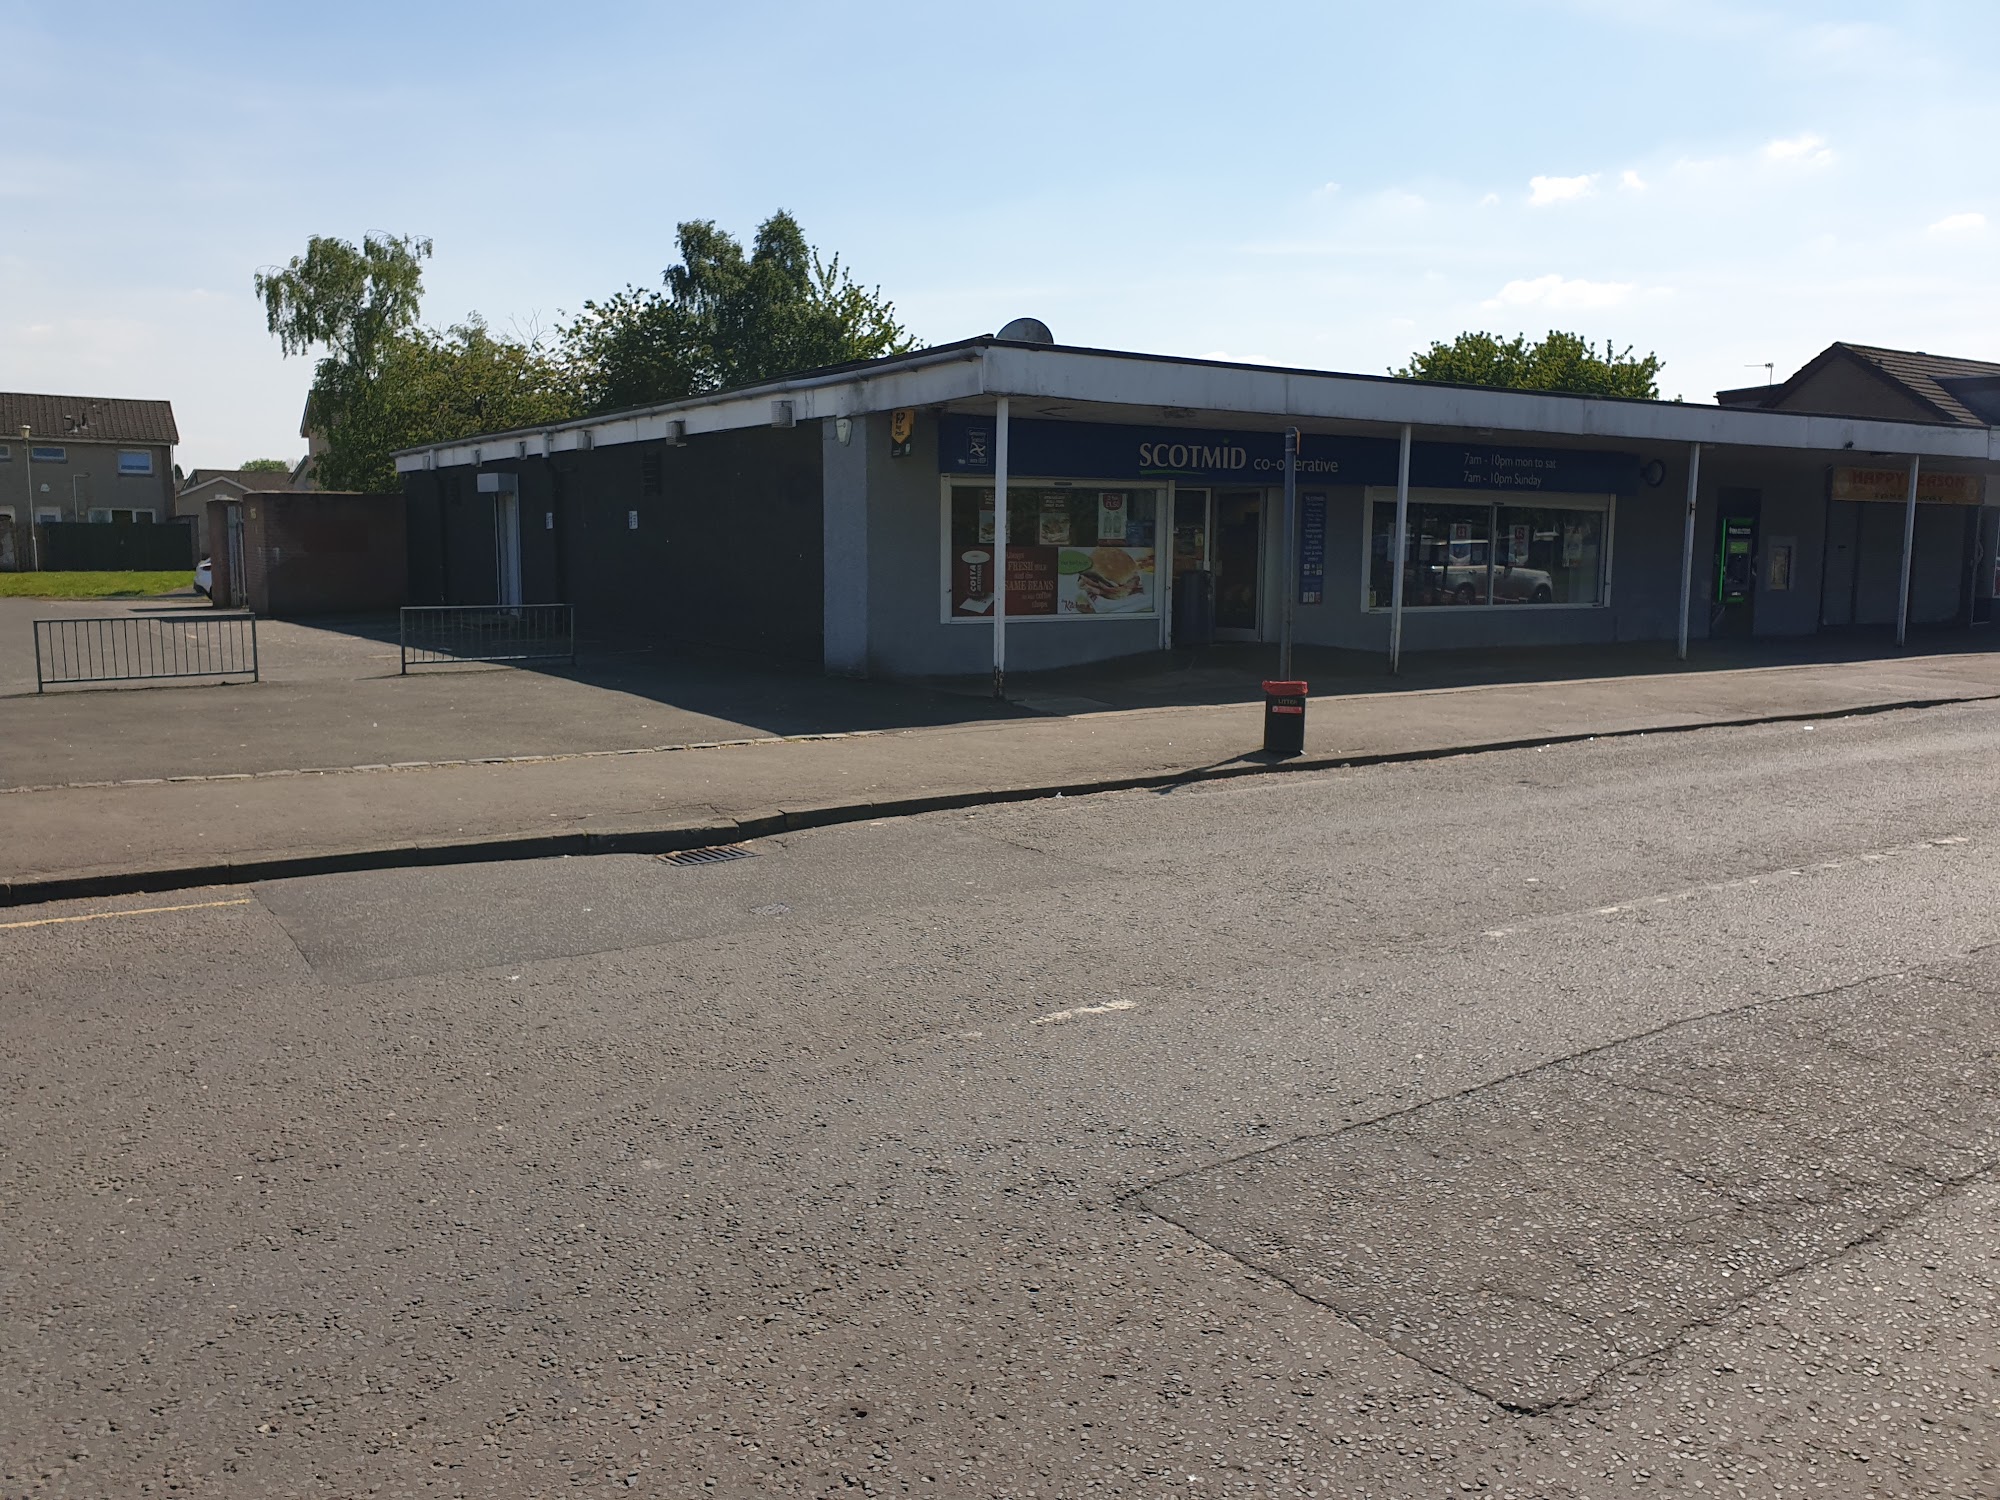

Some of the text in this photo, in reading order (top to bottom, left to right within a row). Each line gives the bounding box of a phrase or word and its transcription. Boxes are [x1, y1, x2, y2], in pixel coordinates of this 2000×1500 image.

[1139, 443, 1339, 473] SCOTMID co-oerative
[1463, 452, 1482, 465] 7am
[1490, 454, 1513, 469] 10pm
[1515, 458, 1533, 468] mon
[1534, 458, 1544, 468] to
[1545, 459, 1557, 469] sat
[1463, 470, 1481, 483] 7am
[1490, 472, 1513, 487] 10pm
[1514, 473, 1542, 488] Sunday
[1851, 470, 1968, 488] HAPPY EASON
[1008, 561, 1034, 571] FRESH
[969, 565, 977, 592] COSTA
[1004, 580, 1054, 591] SAME BEANS
